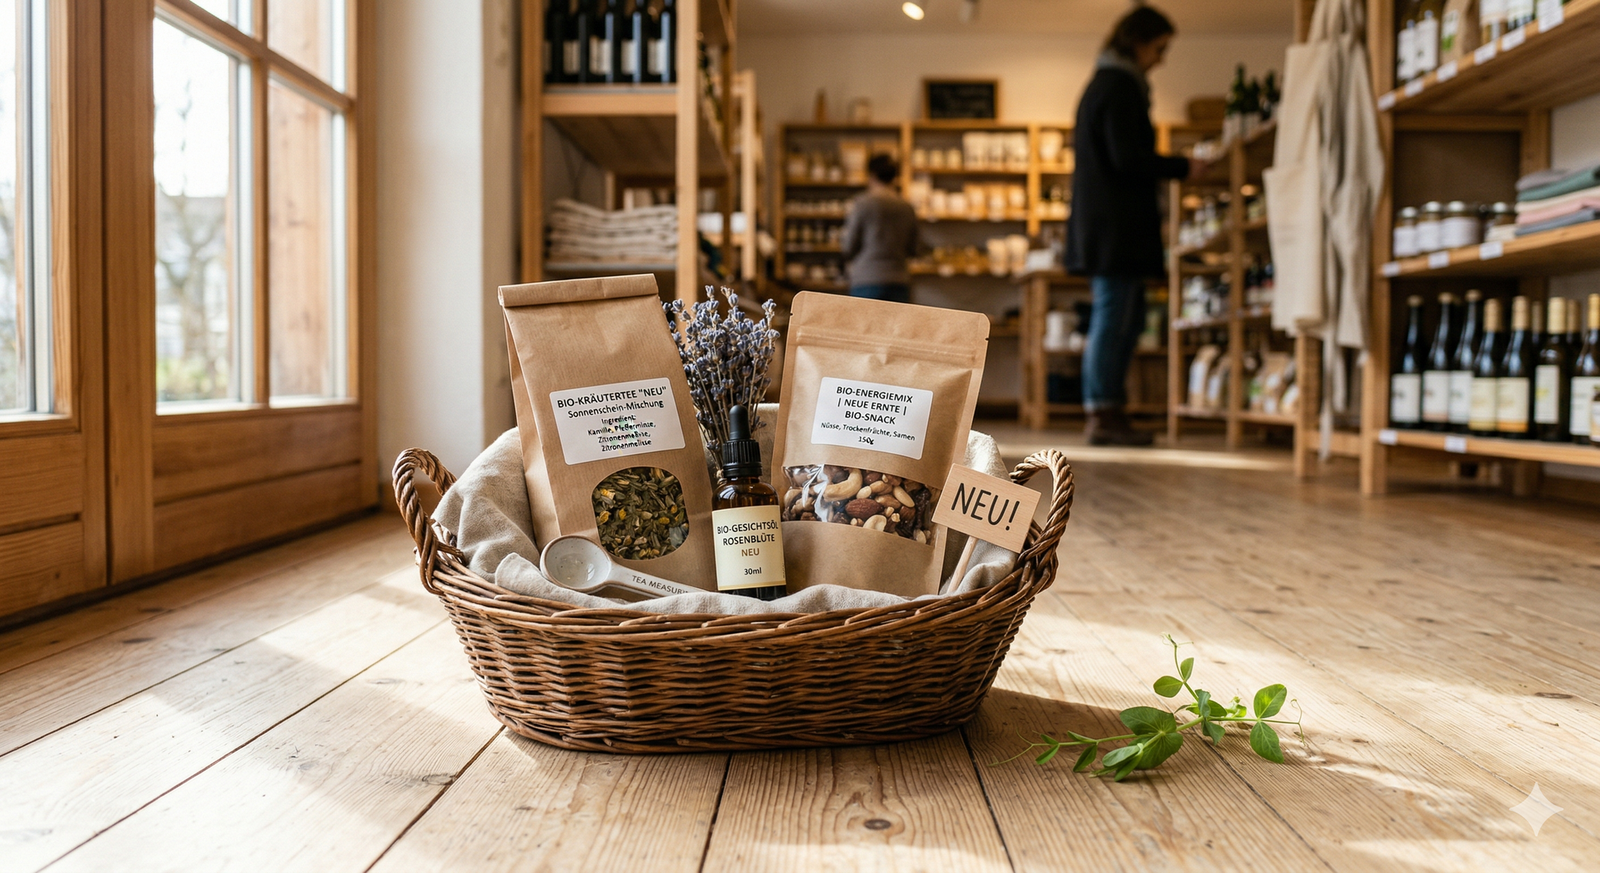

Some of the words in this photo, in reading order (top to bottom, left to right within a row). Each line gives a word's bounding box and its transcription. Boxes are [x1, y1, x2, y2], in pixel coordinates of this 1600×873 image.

[557, 390, 638, 408] BIO-KRÄUTERTEE
[638, 386, 667, 397] "NEU"
[836, 386, 913, 403] BIO-ENERGIEMIX
[568, 400, 665, 418] Sonnenschein-Mischung
[844, 399, 869, 409] NEUE
[871, 402, 901, 413] ERNTE
[845, 411, 896, 425] BIO-SNACK
[893, 431, 915, 441] Samen
[951, 482, 1020, 531] NEU!
[717, 520, 778, 534] BIO-GESICHTSÖL
[723, 533, 775, 545] ROSENBLÜTE
[741, 548, 760, 556] NEU
[744, 567, 762, 575] 30ml
[632, 575, 647, 585] TEA
